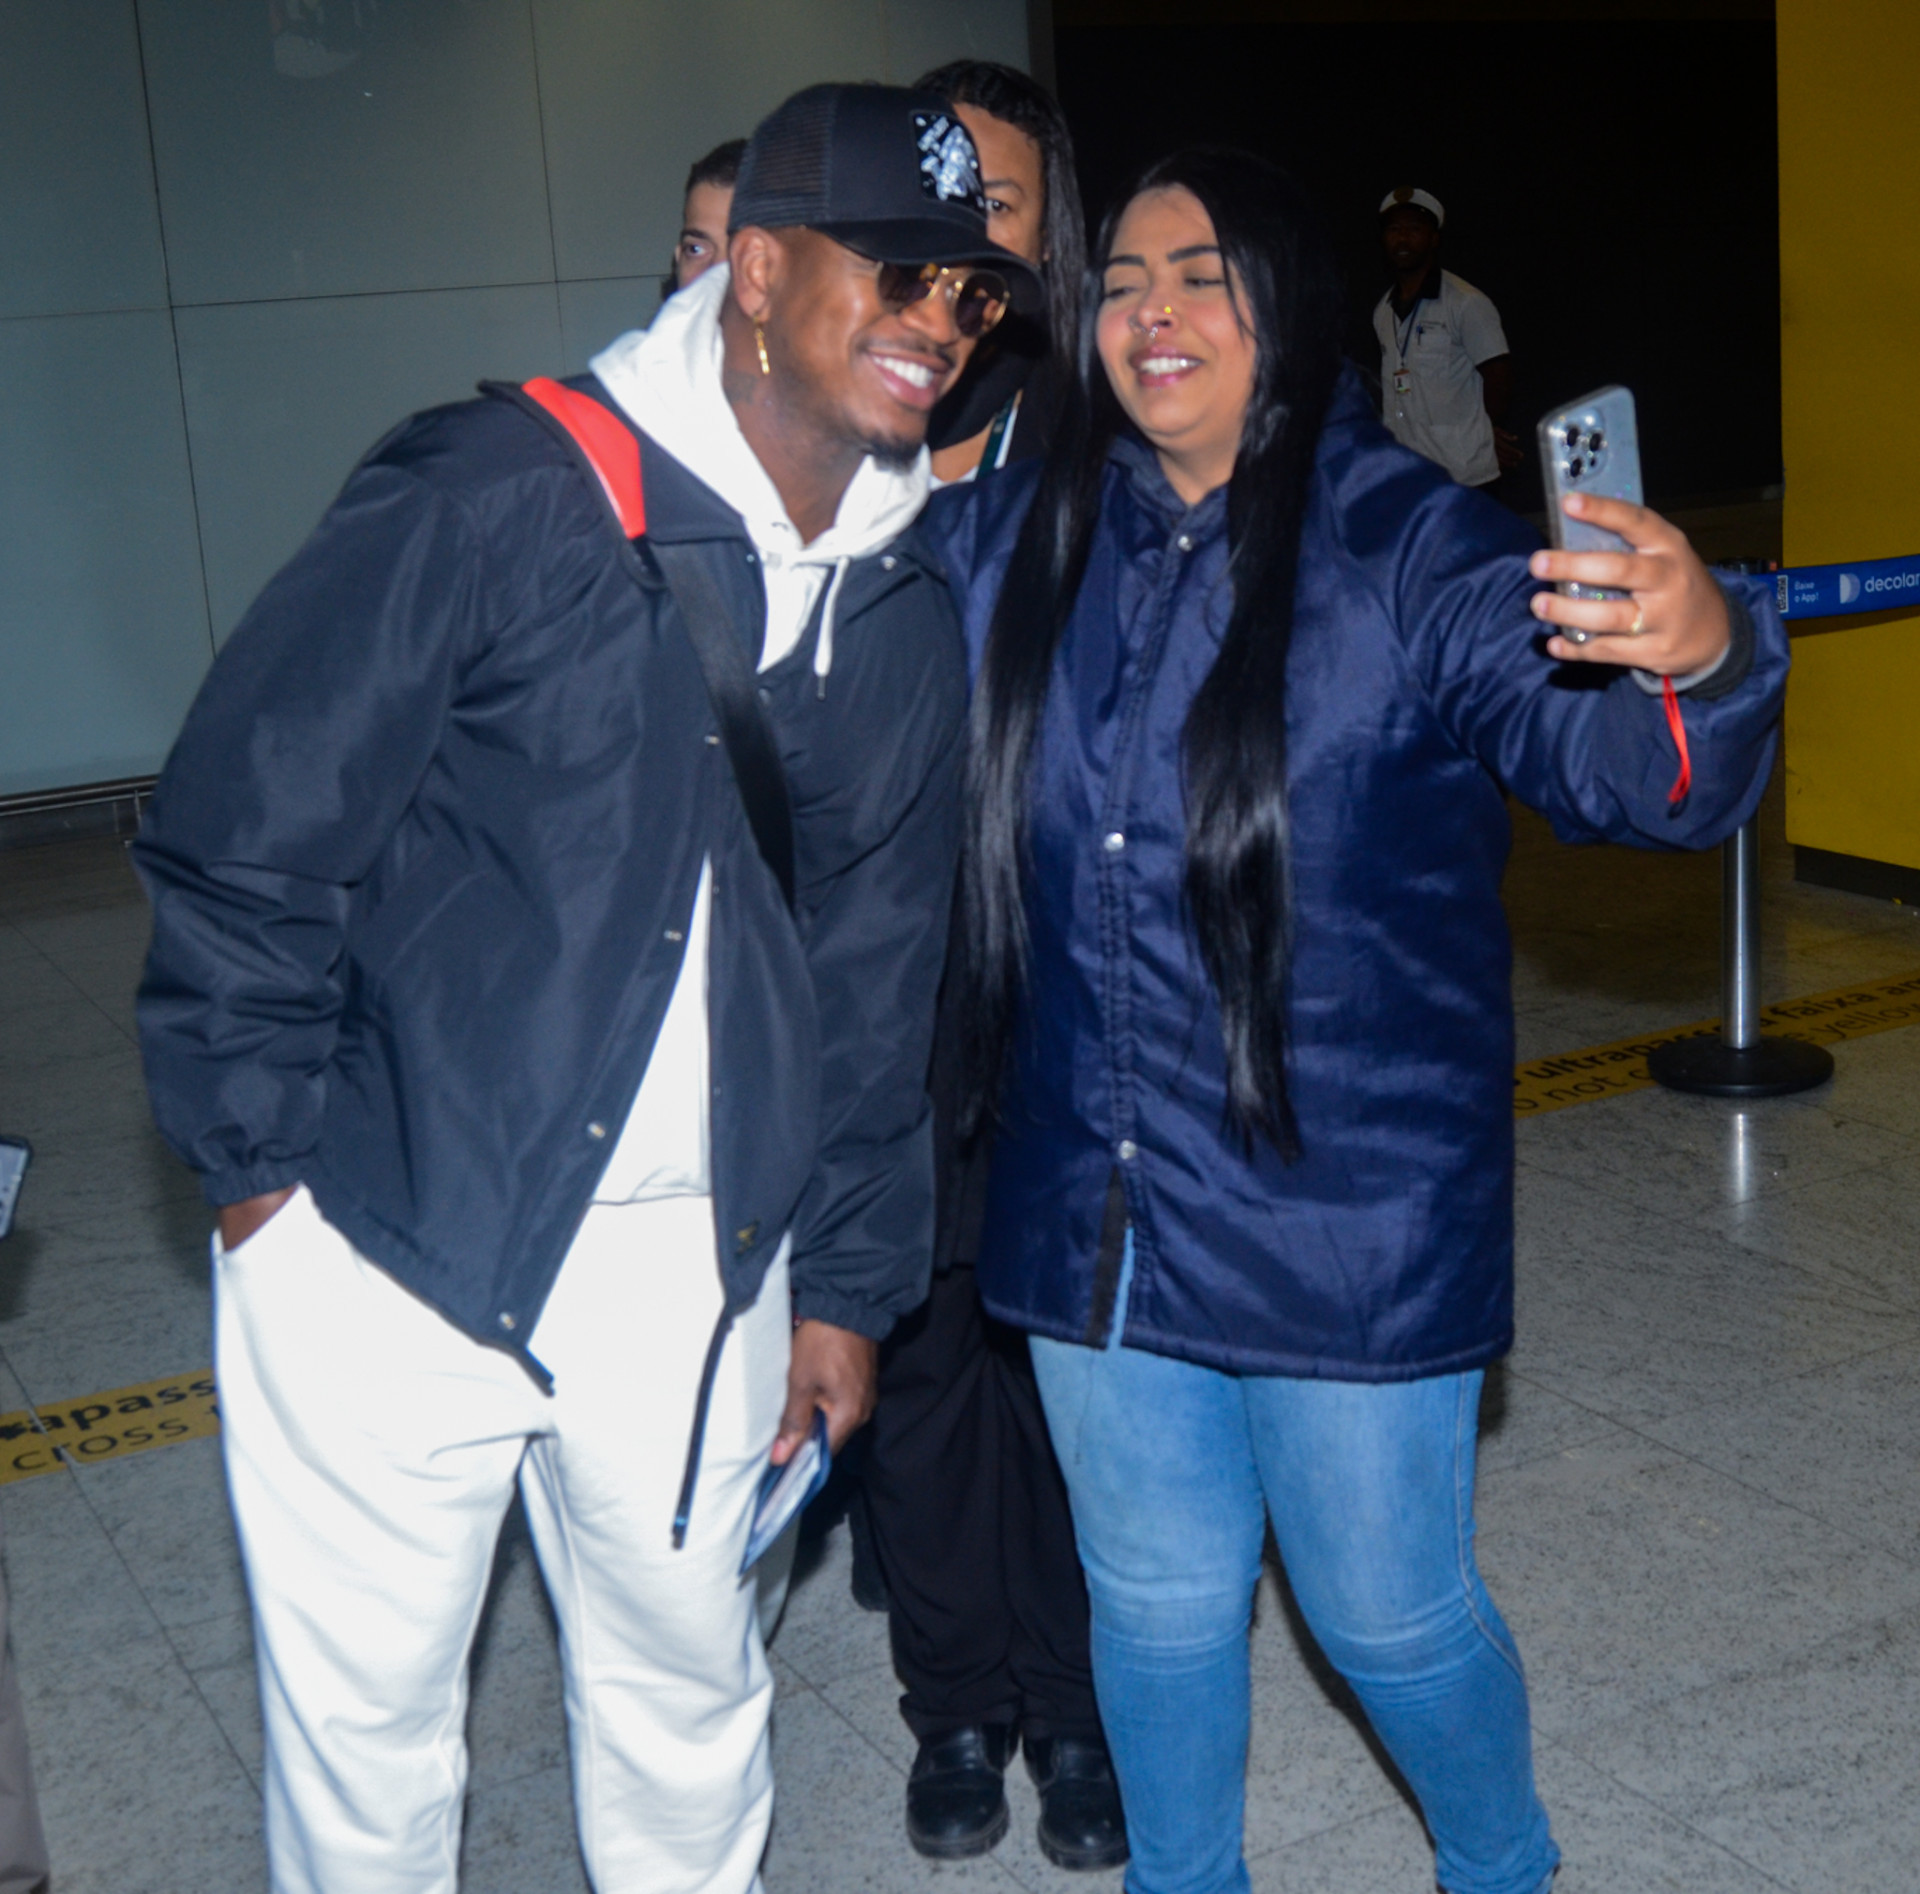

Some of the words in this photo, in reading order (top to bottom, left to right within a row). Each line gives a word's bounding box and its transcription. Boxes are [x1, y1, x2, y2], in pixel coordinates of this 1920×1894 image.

[1864, 571, 1920, 593] decolar
[1769, 993, 1880, 1019] faixa
[1544, 1074, 1629, 1102] not
[12, 1417, 190, 1471] cross
